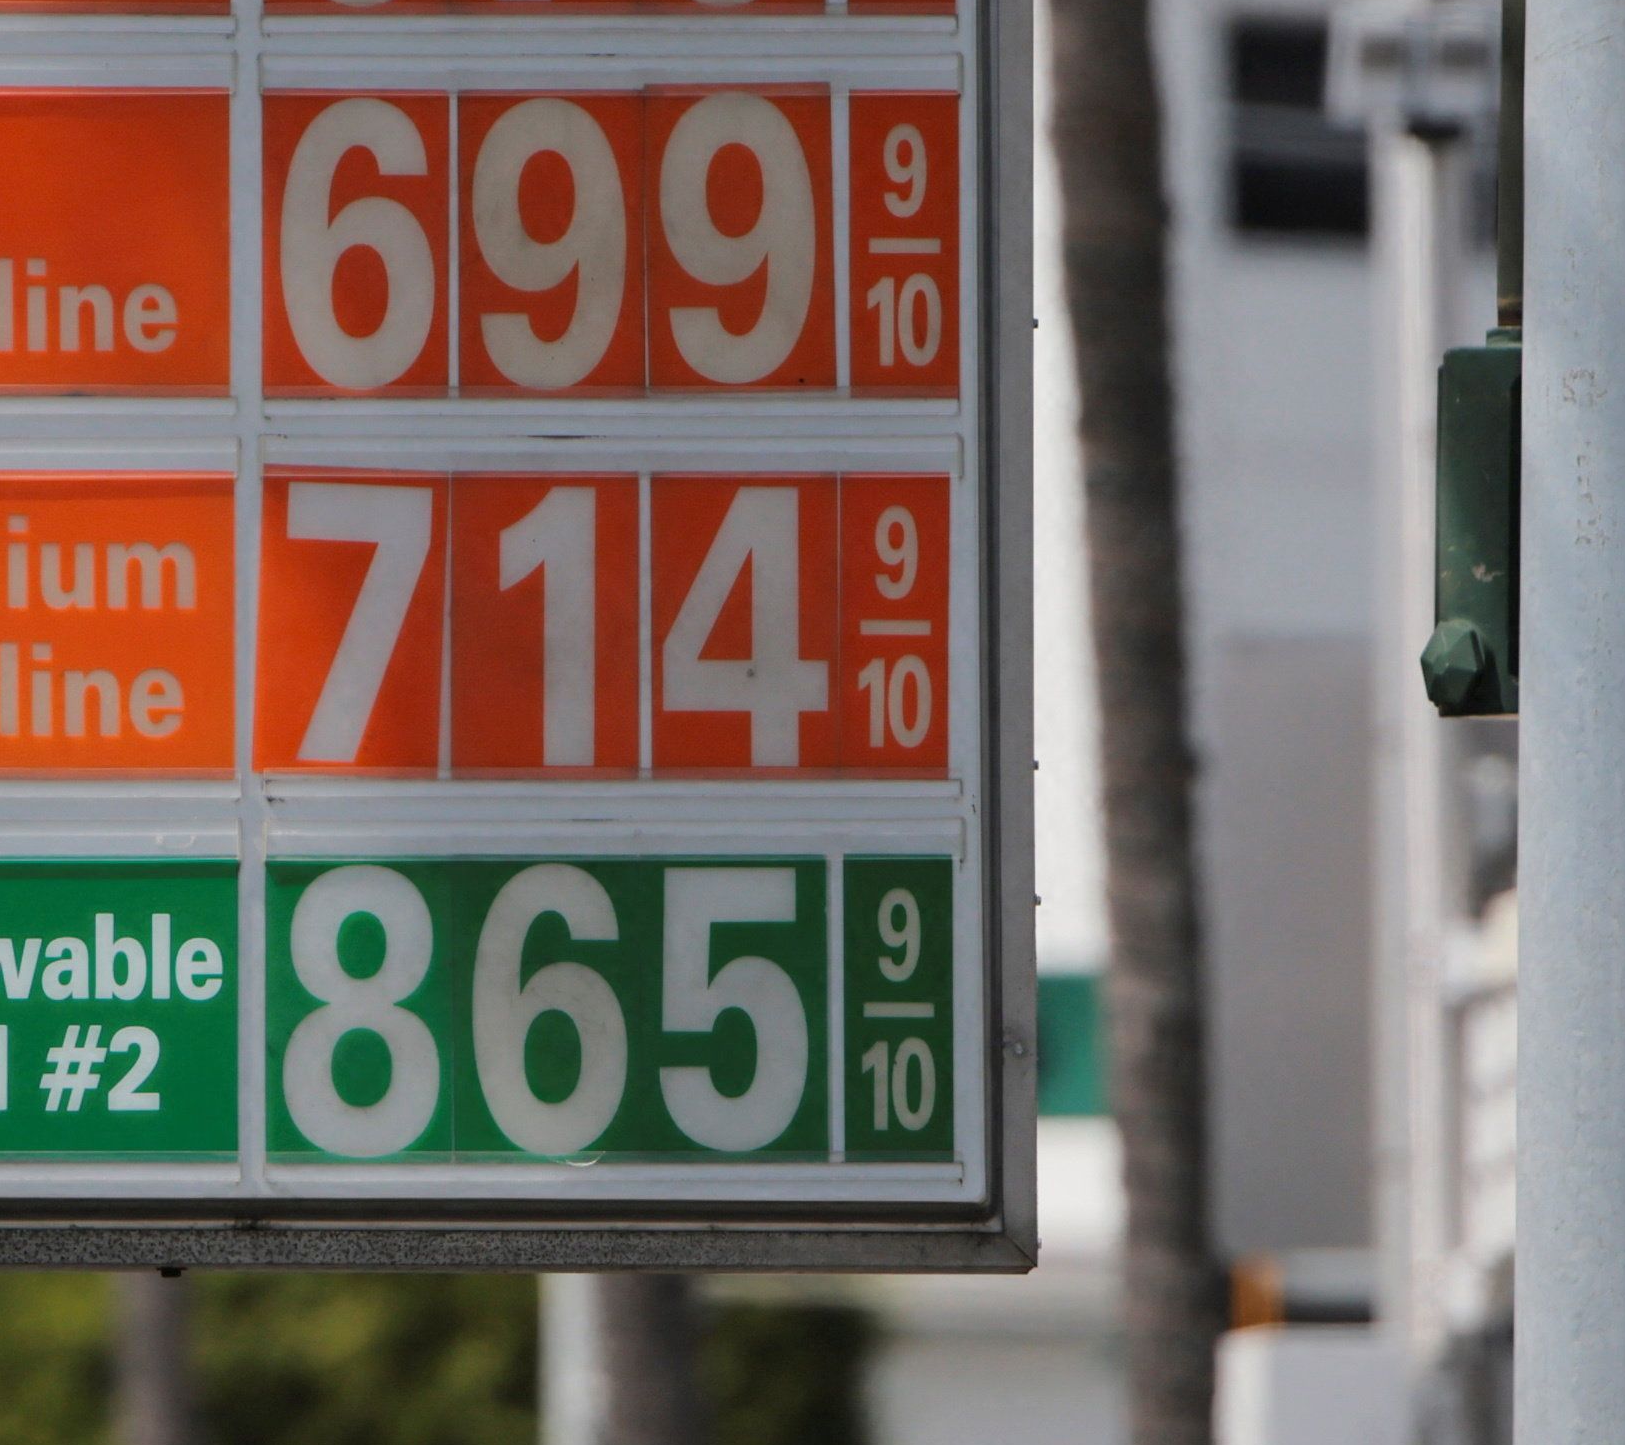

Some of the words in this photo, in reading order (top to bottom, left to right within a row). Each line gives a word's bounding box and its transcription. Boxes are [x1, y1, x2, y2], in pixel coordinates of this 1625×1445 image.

[281, 94, 815, 391] 699
[287, 480, 829, 766] 714
[40, 1024, 160, 1112] #2
[283, 863, 809, 1156] 865
